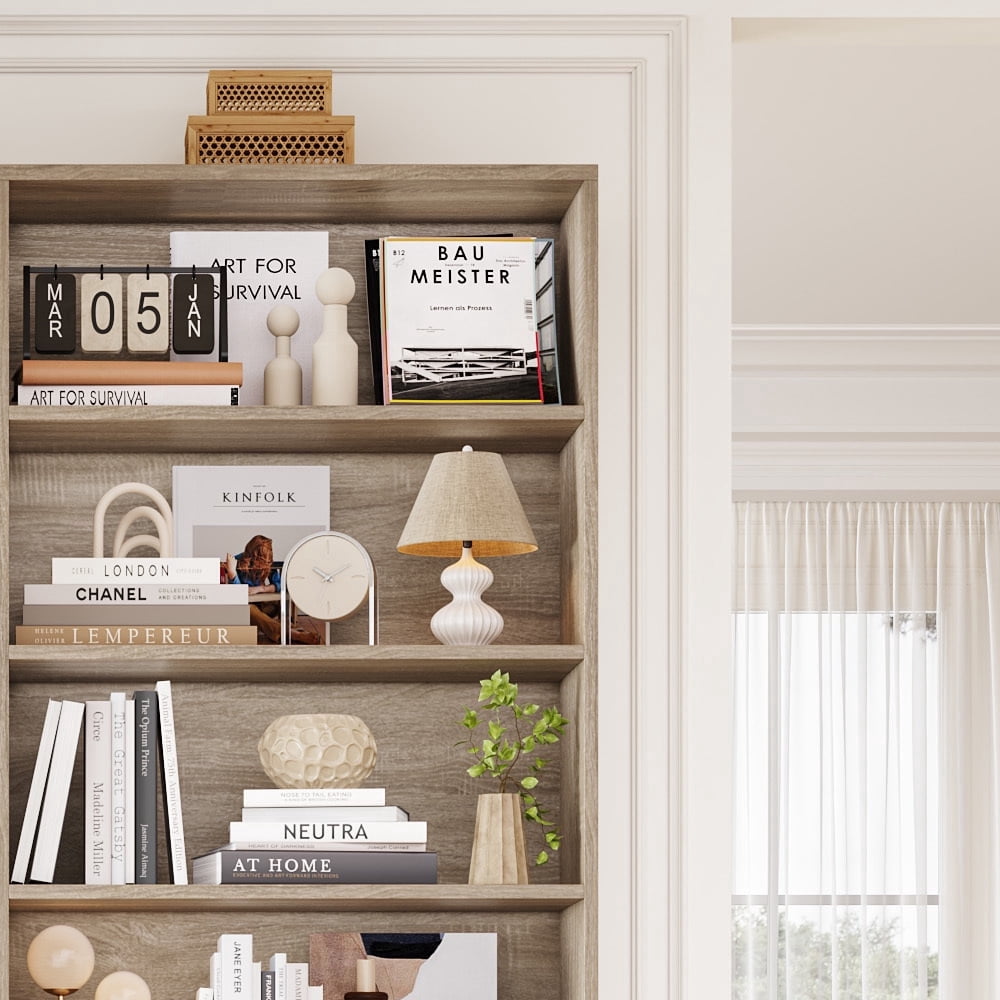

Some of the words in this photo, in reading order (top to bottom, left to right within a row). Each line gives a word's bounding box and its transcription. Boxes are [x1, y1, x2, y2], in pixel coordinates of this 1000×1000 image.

[438, 245, 485, 261] BAU
[210, 258, 247, 274] ART
[255, 258, 297, 274] FOR
[410, 269, 510, 284] MEISTER
[47, 282, 63, 338] MAR
[187, 283, 201, 338] JAN
[30, 390, 54, 406] ART
[59, 390, 85, 406] FOR
[89, 390, 148, 406] SURVIVAL
[222, 491, 297, 503] KINFOLK
[103, 564, 170, 577] LONDON
[75, 587, 147, 601] CHANEL
[72, 627, 230, 645] LEMPEREUR
[141, 699, 150, 715] The
[92, 711, 104, 742] Circe
[114, 712, 126, 740] The
[138, 716, 150, 747] Opium
[114, 749, 126, 796] Great
[141, 748, 150, 777] Prince
[92, 782, 104, 837] Madeline
[111, 806, 126, 863] Gatsby
[284, 824, 369, 840] NEUTRA
[92, 841, 104, 877] Miller
[232, 858, 261, 872] AT
[268, 858, 332, 872] HOME
[234, 941, 242, 966] JANE
[234, 968, 242, 993] EYER
[295, 968, 303, 1000] MADAME
